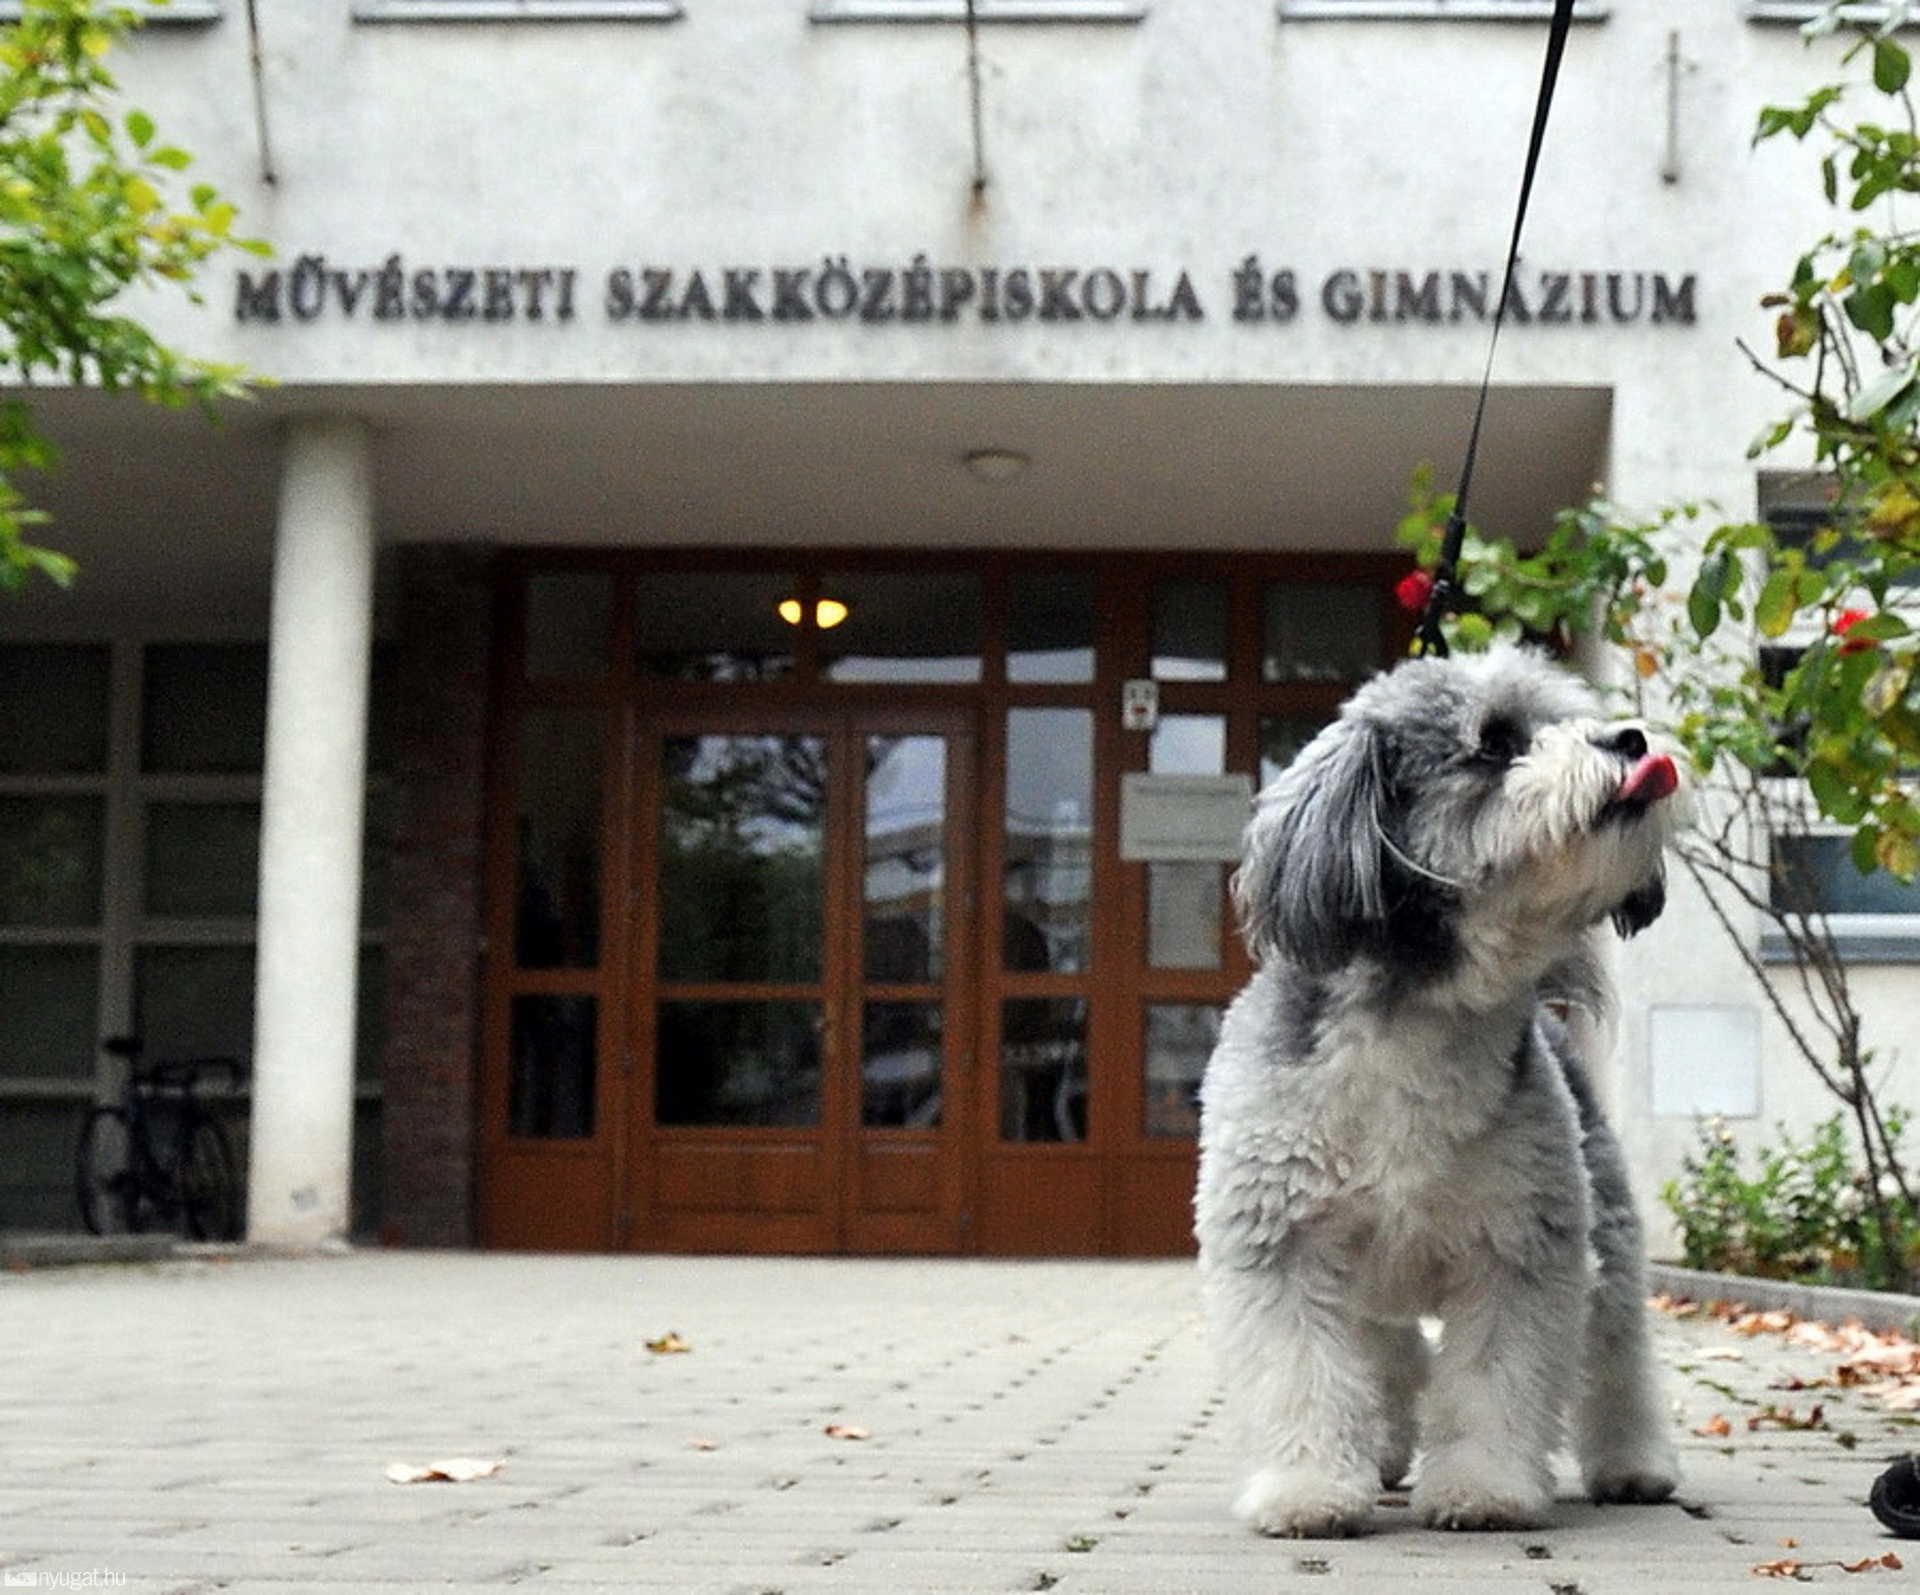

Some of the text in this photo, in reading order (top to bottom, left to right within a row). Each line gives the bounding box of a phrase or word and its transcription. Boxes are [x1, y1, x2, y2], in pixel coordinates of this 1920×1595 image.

[234, 254, 1700, 325] MŰVÉSZETI SZAKKÖZÉPISKOLA ÉS GIMNÁZIUM
